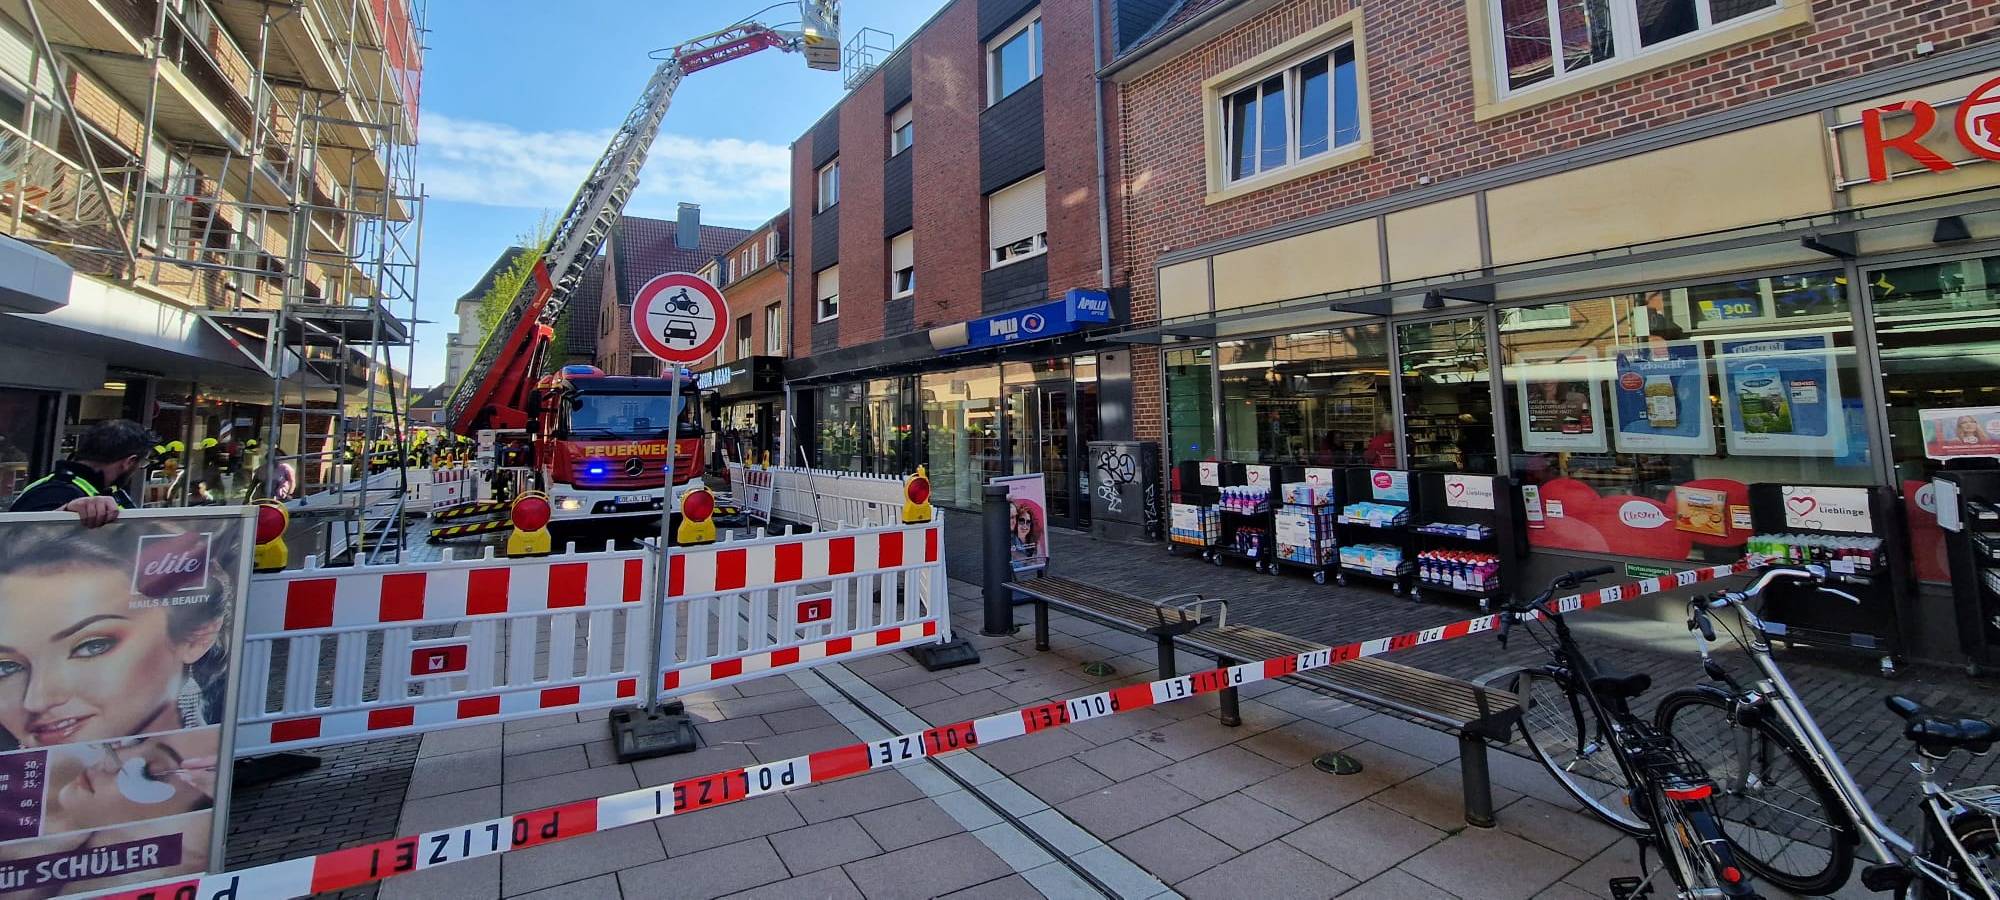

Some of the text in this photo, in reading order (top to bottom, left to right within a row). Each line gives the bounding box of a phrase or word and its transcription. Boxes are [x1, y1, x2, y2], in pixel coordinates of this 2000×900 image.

[1077, 297, 1107, 311] APOLLO
[990, 317, 1018, 337] APOLLO
[1819, 507, 1865, 517] Lieblinge
[144, 552, 201, 576] elite
[162, 598, 169, 607] &
[172, 595, 210, 606] BEAUTY
[1165, 667, 1242, 699] POLIZEI
[1029, 693, 1120, 731] POLIZEI
[867, 723, 978, 767] POLIZEI
[655, 762, 795, 815] POLIZEI
[370, 811, 560, 878] POLIZEI
[36, 843, 160, 884] SCHÜLER
